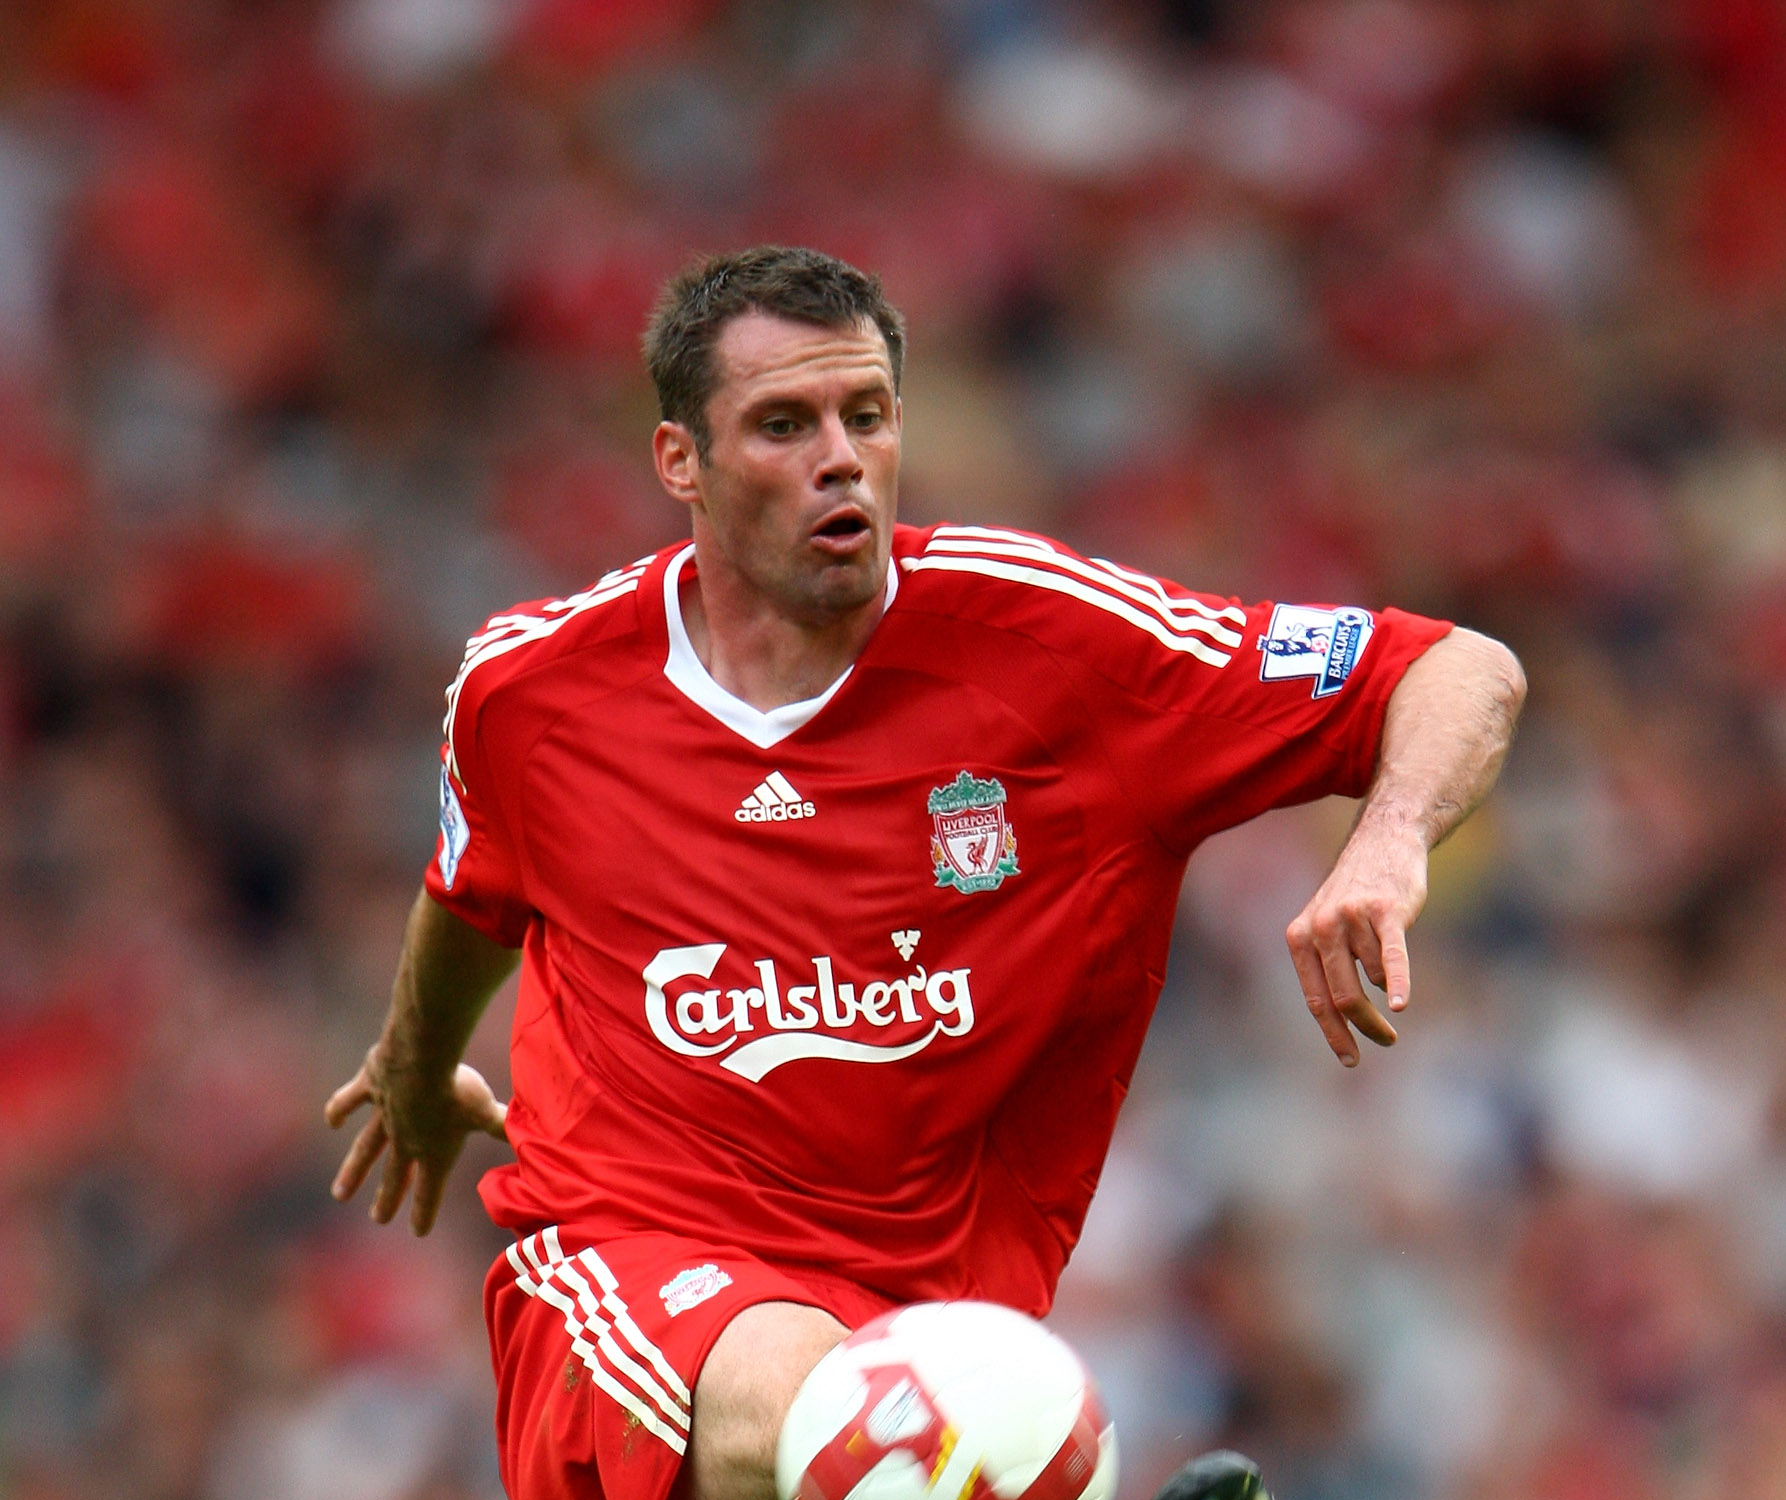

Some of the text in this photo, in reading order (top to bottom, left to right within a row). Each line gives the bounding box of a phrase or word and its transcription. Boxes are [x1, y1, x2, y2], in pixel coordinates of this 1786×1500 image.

[734, 801, 816, 822] adidas
[943, 814, 997, 831] LIVERPOOL
[642, 943, 975, 1060] Carlsberg
